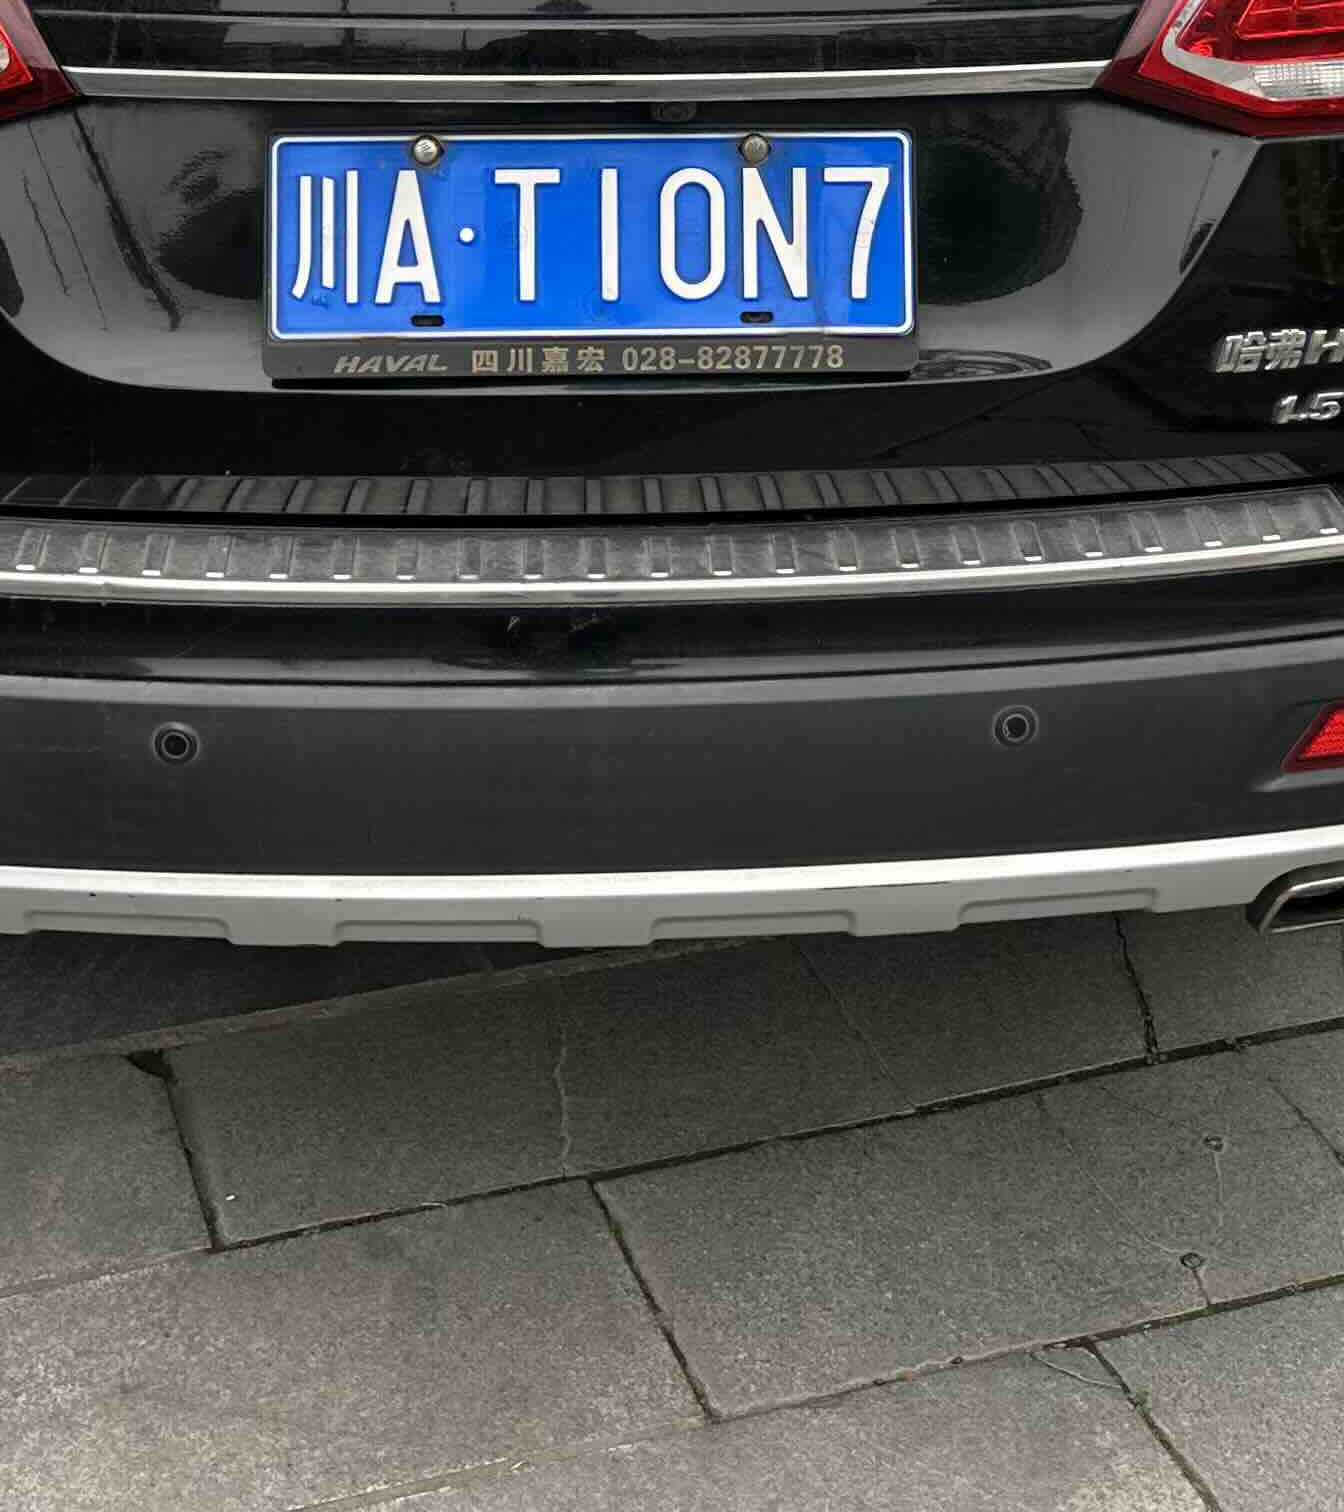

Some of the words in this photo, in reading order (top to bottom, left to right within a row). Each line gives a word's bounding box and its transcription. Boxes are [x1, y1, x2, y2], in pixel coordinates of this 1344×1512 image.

[334, 354, 448, 374] HAVAL
[471, 346, 605, 374] 四川嘉宏
[621, 345, 844, 372] 028-82877778
